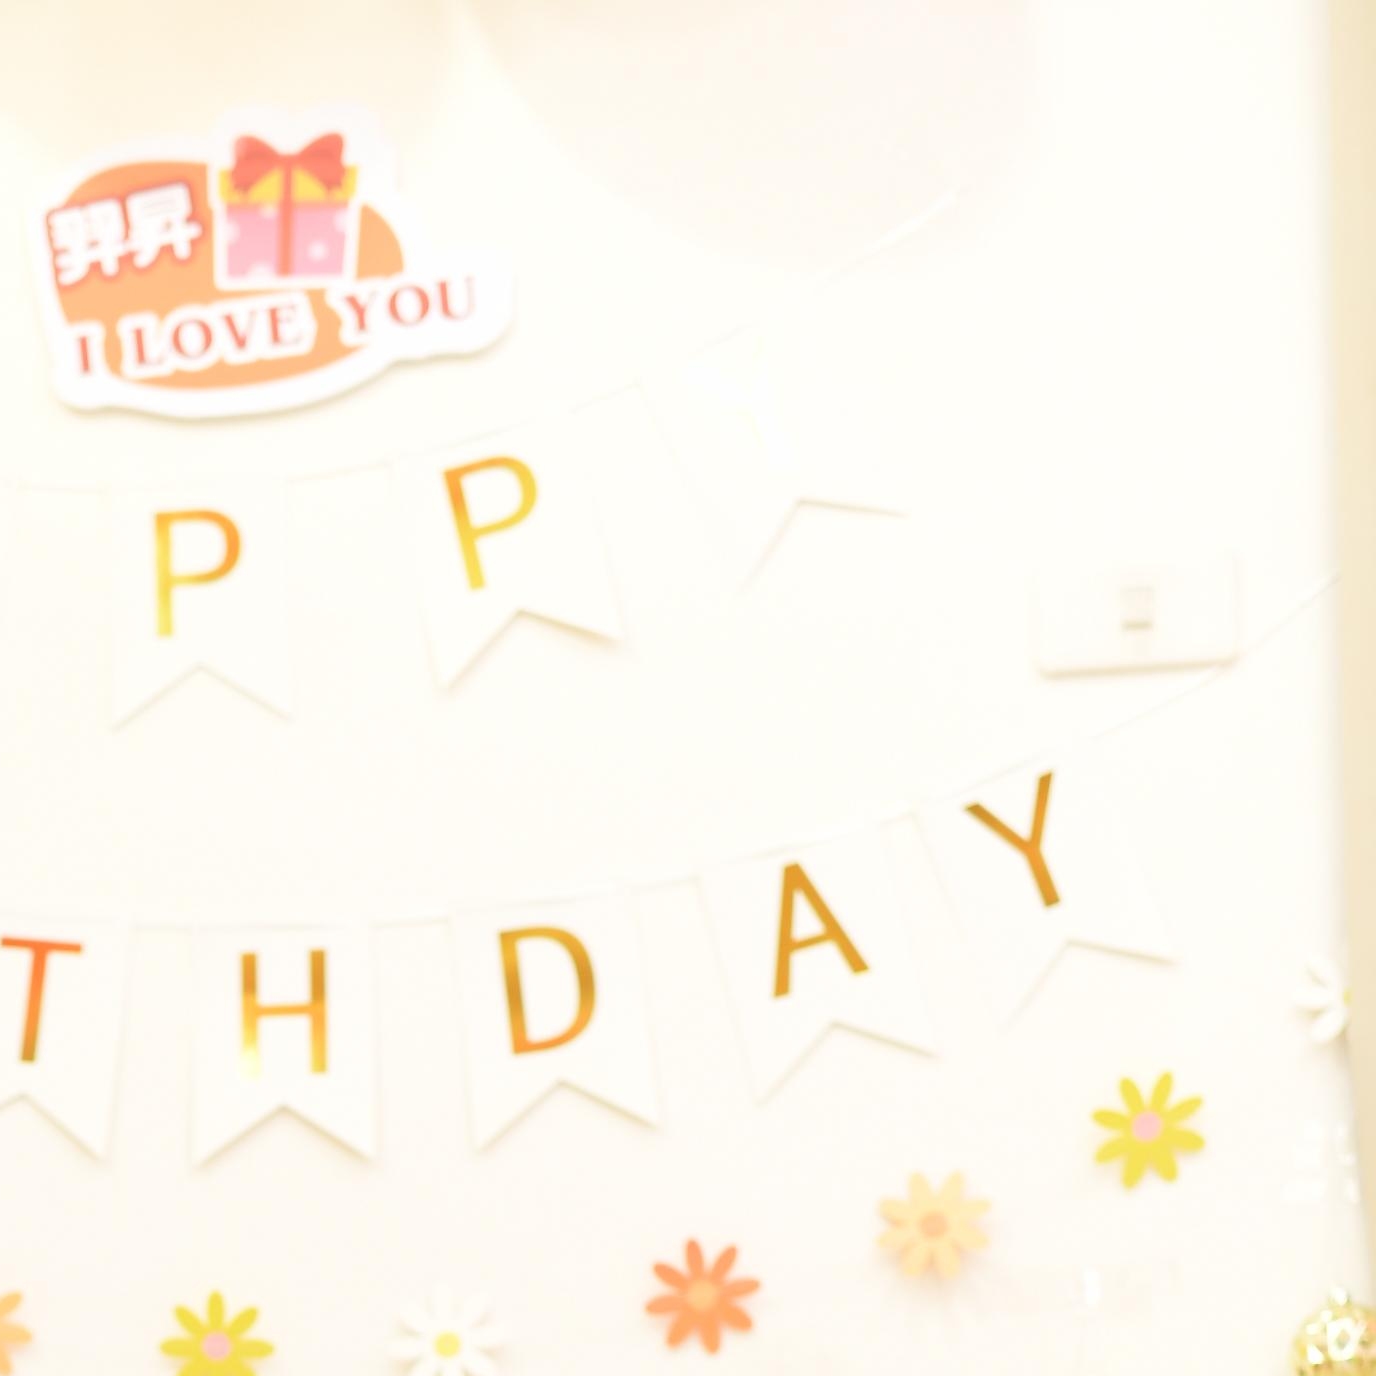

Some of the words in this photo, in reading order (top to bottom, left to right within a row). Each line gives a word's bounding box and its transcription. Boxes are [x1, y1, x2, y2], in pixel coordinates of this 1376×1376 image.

[76, 332, 93, 376] I
[132, 302, 300, 368] LOVE
[342, 276, 477, 335] YOU
